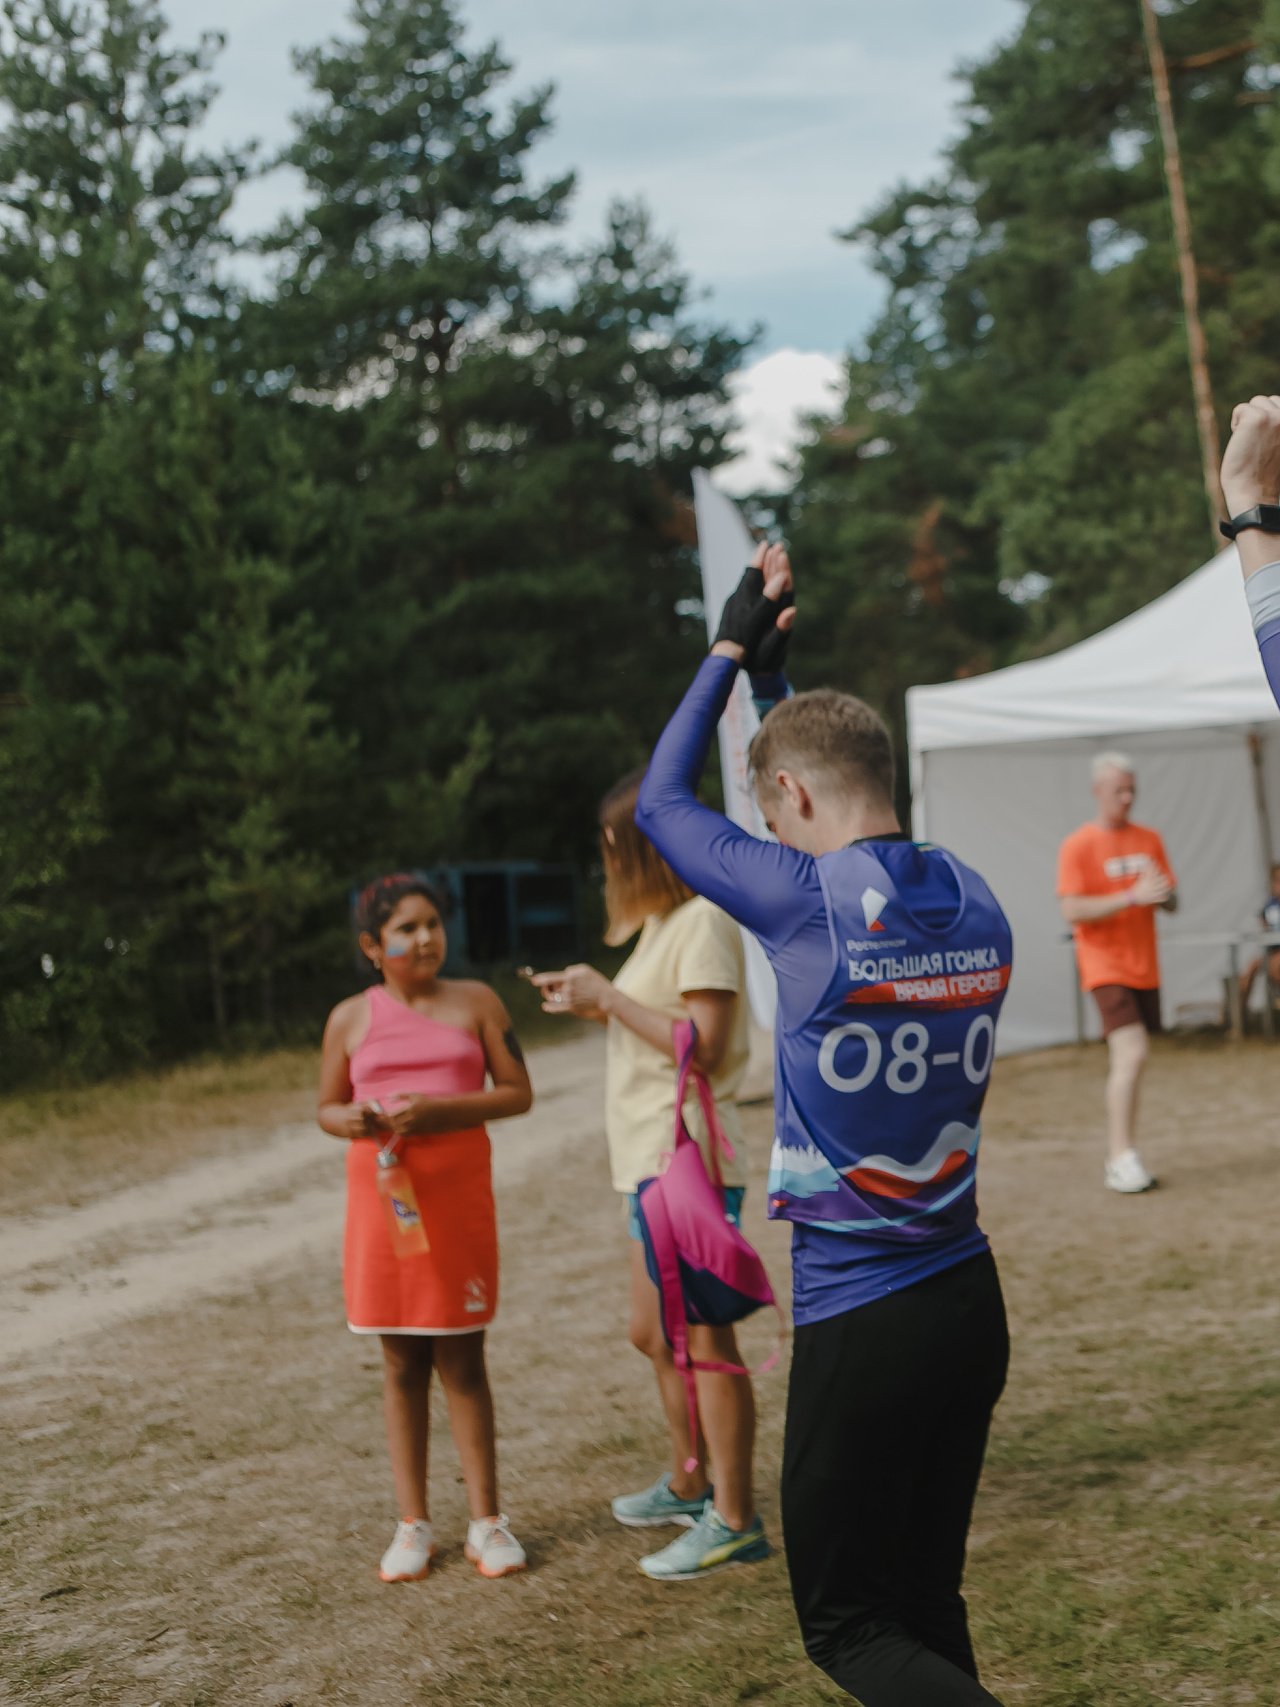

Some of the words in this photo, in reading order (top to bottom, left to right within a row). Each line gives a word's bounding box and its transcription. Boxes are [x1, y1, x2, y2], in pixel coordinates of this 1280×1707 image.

[849, 952, 943, 981] БОЛЬШАЯ
[945, 947, 1000, 973] ГОНКА
[893, 978, 949, 1002] ВРЕМЯ
